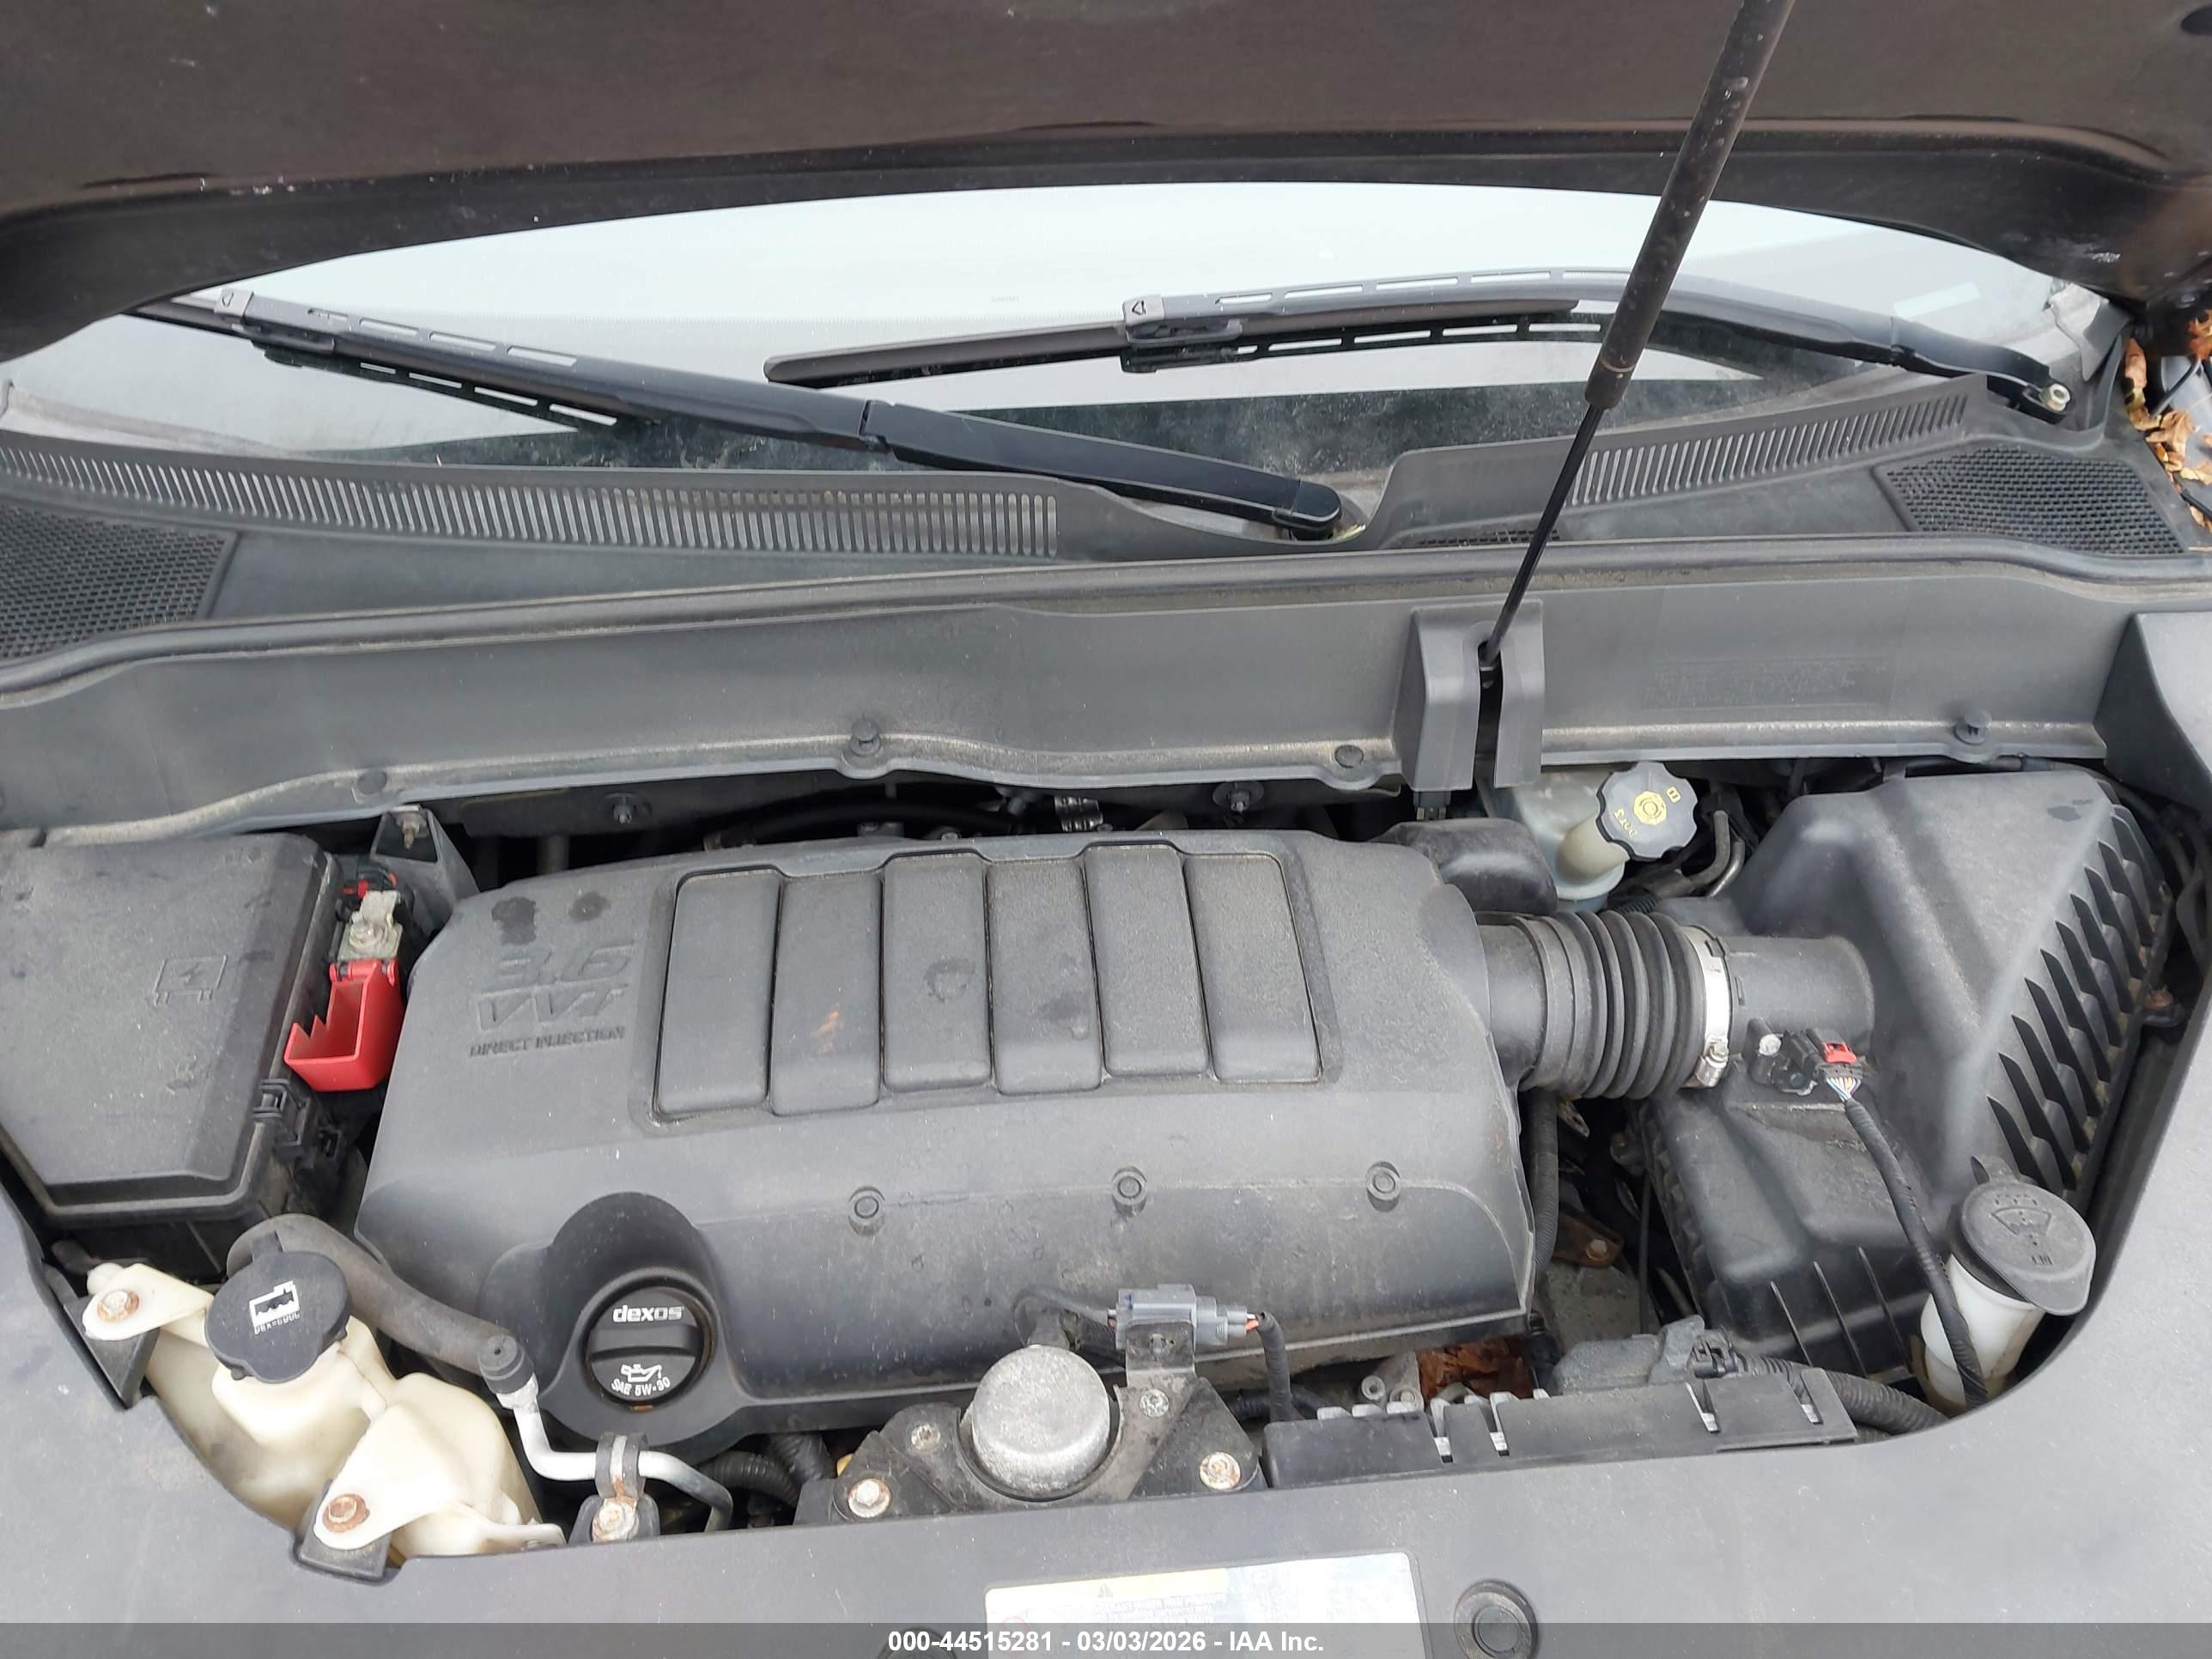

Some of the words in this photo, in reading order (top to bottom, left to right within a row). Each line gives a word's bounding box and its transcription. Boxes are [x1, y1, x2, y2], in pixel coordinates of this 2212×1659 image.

[469, 1037, 529, 1057] DIRECT
[535, 1027, 625, 1048] INJECTION
[612, 1304, 684, 1323] dexos
[611, 1378, 632, 1395] SAE
[634, 1376, 671, 1396] 5W-30
